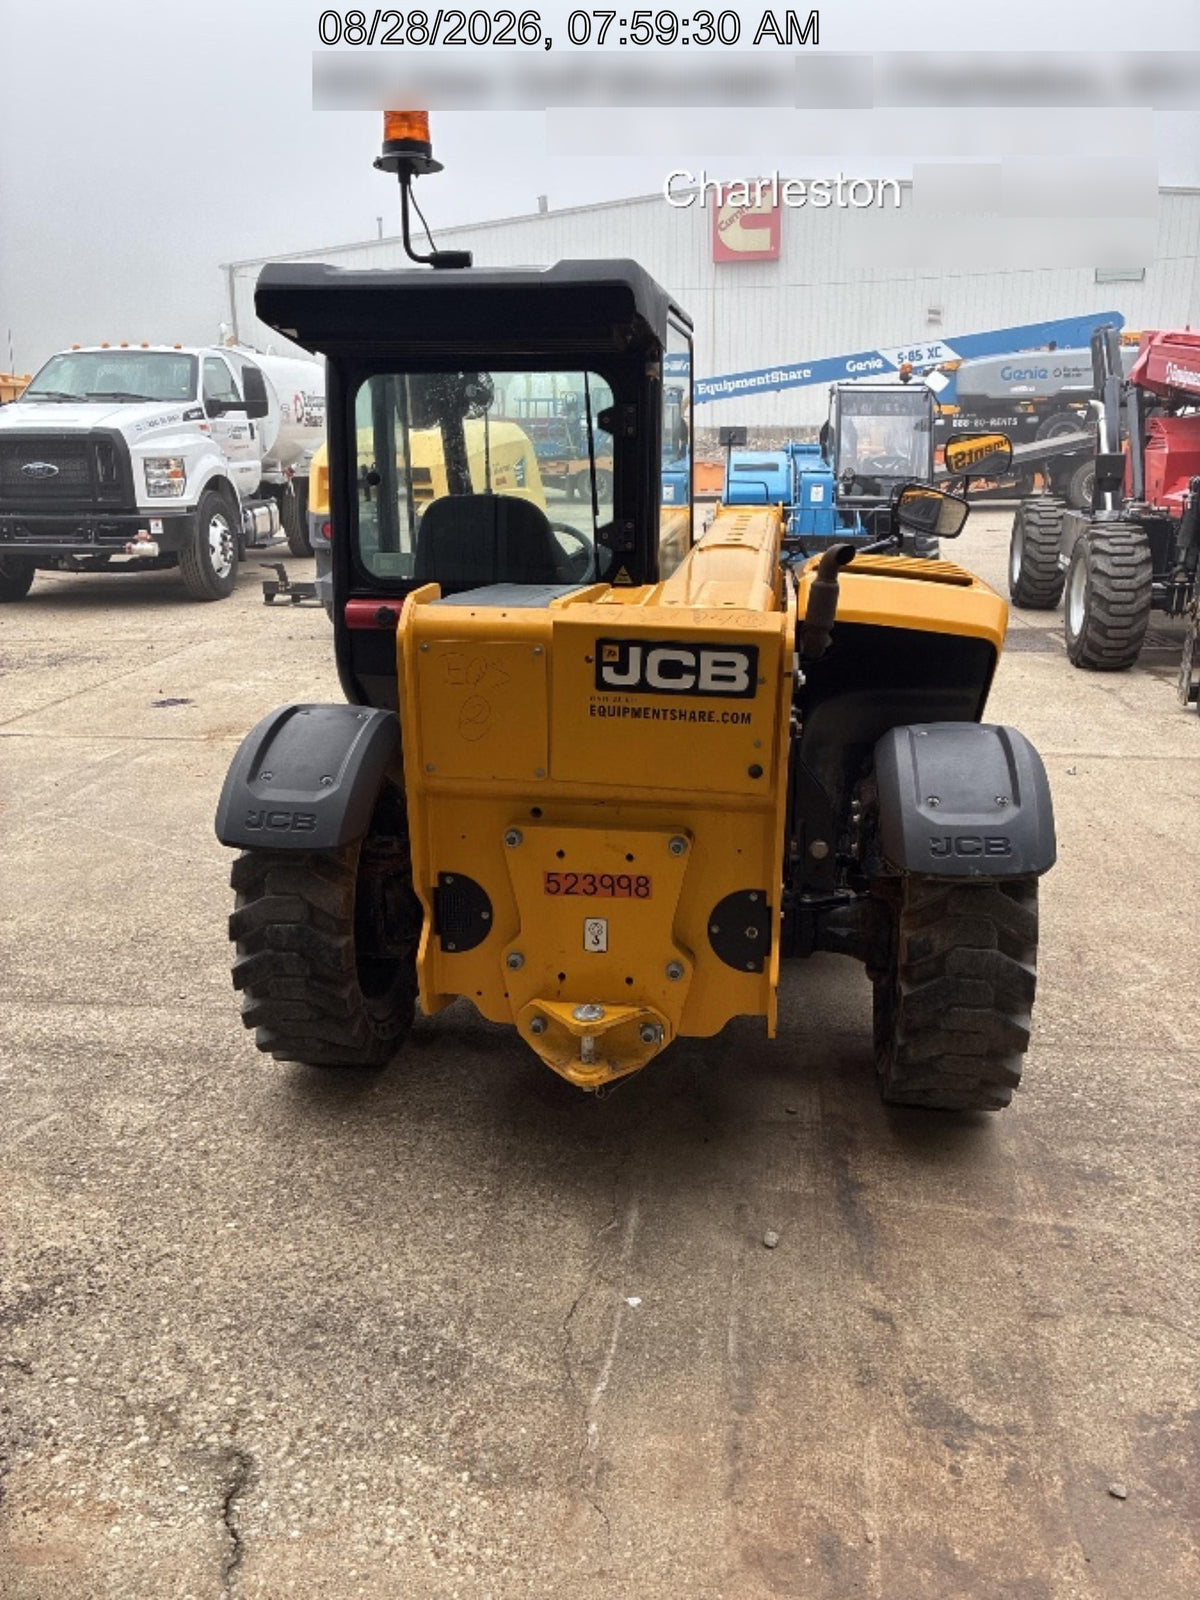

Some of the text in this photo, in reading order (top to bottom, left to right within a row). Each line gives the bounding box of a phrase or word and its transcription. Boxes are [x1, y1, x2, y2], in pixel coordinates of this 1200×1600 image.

[845, 355, 884, 374] Genie
[1000, 365, 1049, 382] Genie
[696, 367, 813, 396] EquipmentShare
[602, 645, 750, 693] JCB
[589, 703, 752, 725] EQUIPMENTSHARE.COM
[245, 809, 318, 832] JCB
[928, 835, 1013, 859] JCB
[545, 872, 651, 898] 523998
